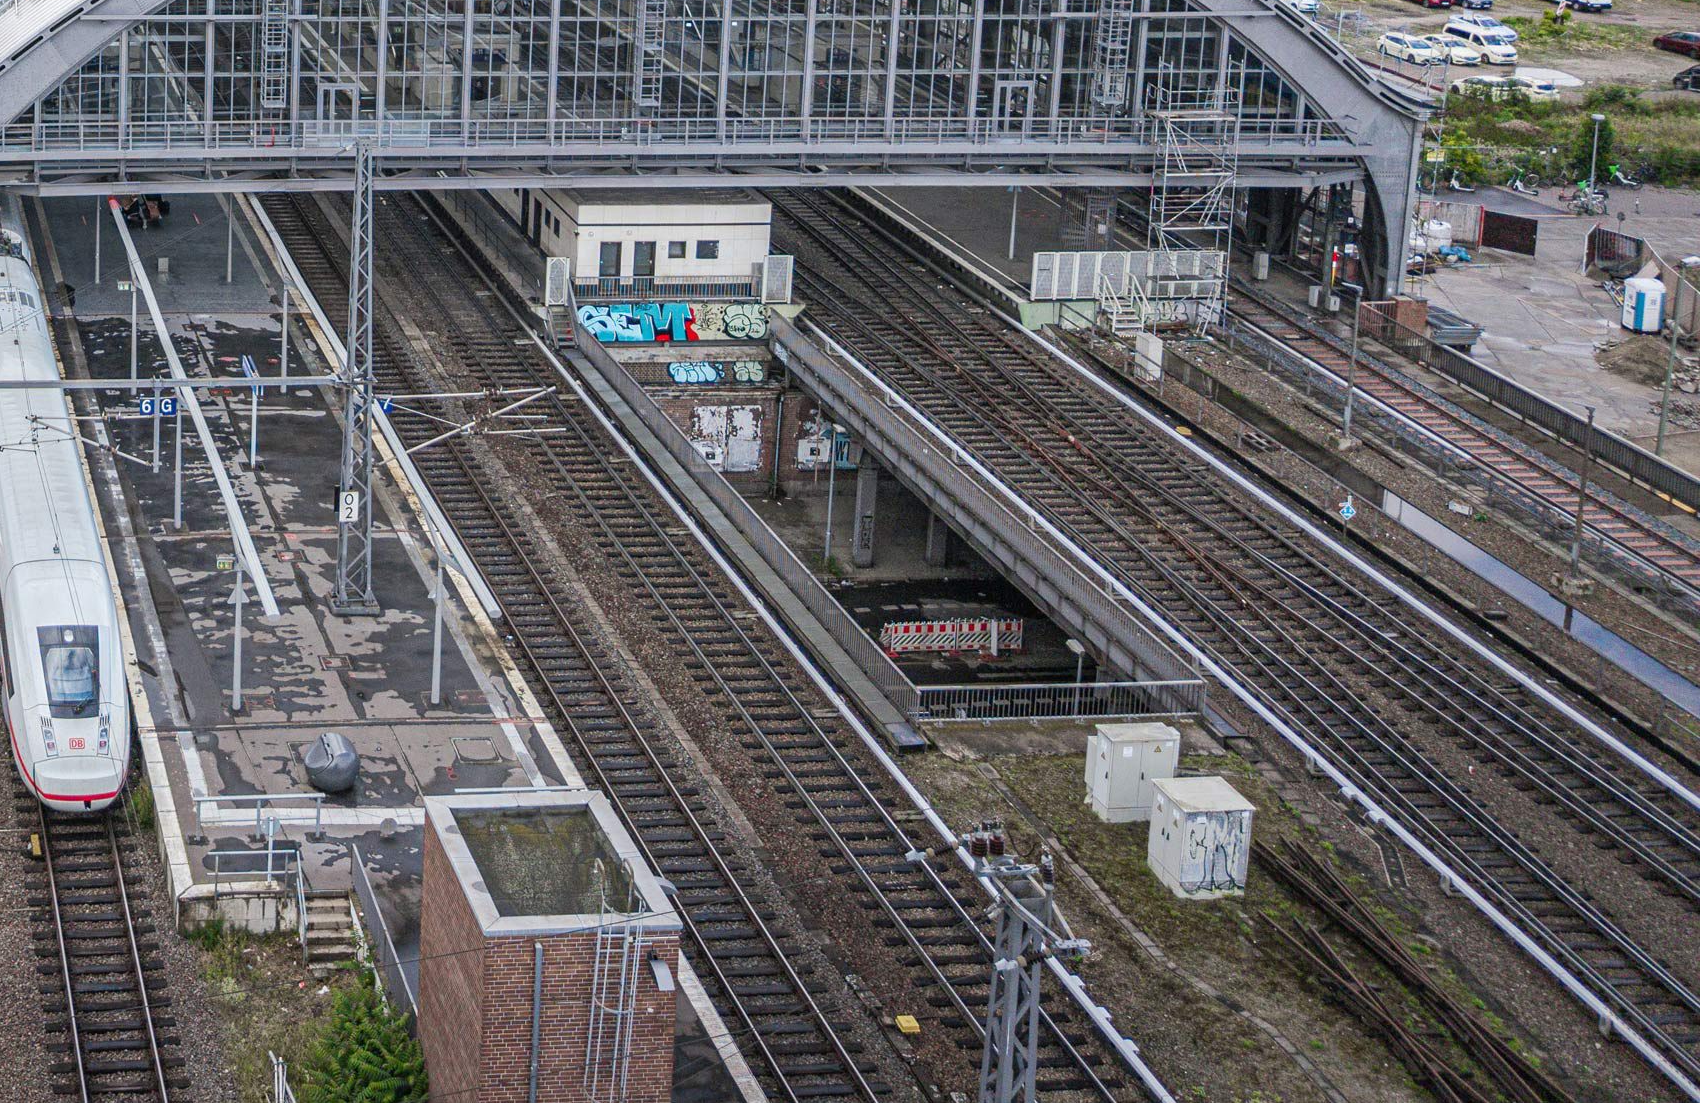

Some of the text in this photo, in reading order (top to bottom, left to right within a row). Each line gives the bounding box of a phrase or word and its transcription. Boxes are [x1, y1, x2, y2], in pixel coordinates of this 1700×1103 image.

[141, 398, 172, 413] 6 G
[71, 739, 84, 748] DB
